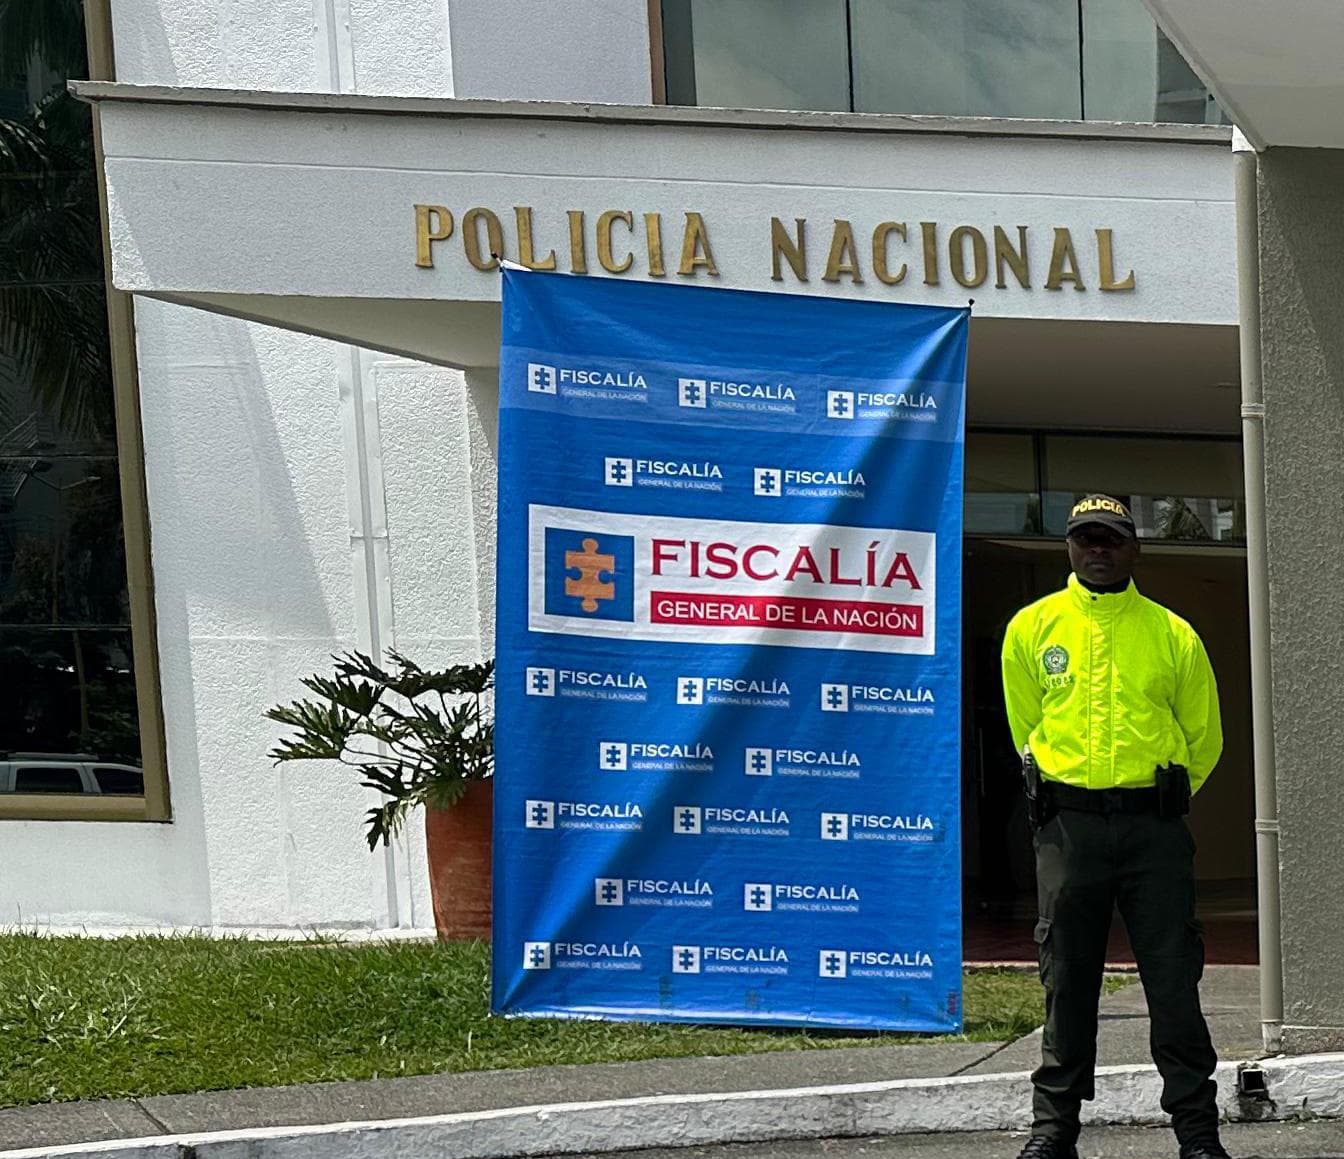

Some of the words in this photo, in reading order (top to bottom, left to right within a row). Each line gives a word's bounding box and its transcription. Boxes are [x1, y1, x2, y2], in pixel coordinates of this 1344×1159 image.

[413, 203, 720, 277] POLICIA
[770, 216, 1136, 293] NACIONAL
[560, 369, 648, 389] FISCALÍA
[710, 382, 796, 400] FISCALÍA
[858, 393, 937, 408] FISCALÍA
[636, 460, 723, 478] FISCALÍA
[784, 469, 866, 486] FISCALÍA
[1071, 498, 1126, 517] POLICIA
[651, 538, 923, 590] FISCALÍA
[657, 599, 761, 621] GENERAL
[765, 604, 796, 622] DE
[802, 607, 829, 625] LA
[833, 607, 918, 630] NACIÓN
[560, 670, 647, 688] FISCALÍA
[706, 678, 790, 694] FISCALÍA
[852, 686, 935, 702] FISCALÍA
[630, 743, 714, 758] FISCALÍA
[776, 750, 860, 766] FISCALÍA
[558, 802, 643, 818] FISCALÍA
[705, 808, 790, 824] FISCALÍA
[852, 814, 934, 830] FISCALÍA
[627, 879, 713, 894] FISCALÍA
[776, 885, 860, 900] FISCALÍA
[555, 941, 642, 957] FISCALÍA
[704, 946, 788, 962] FISCALÍA
[850, 951, 933, 966] FISCALÍA
